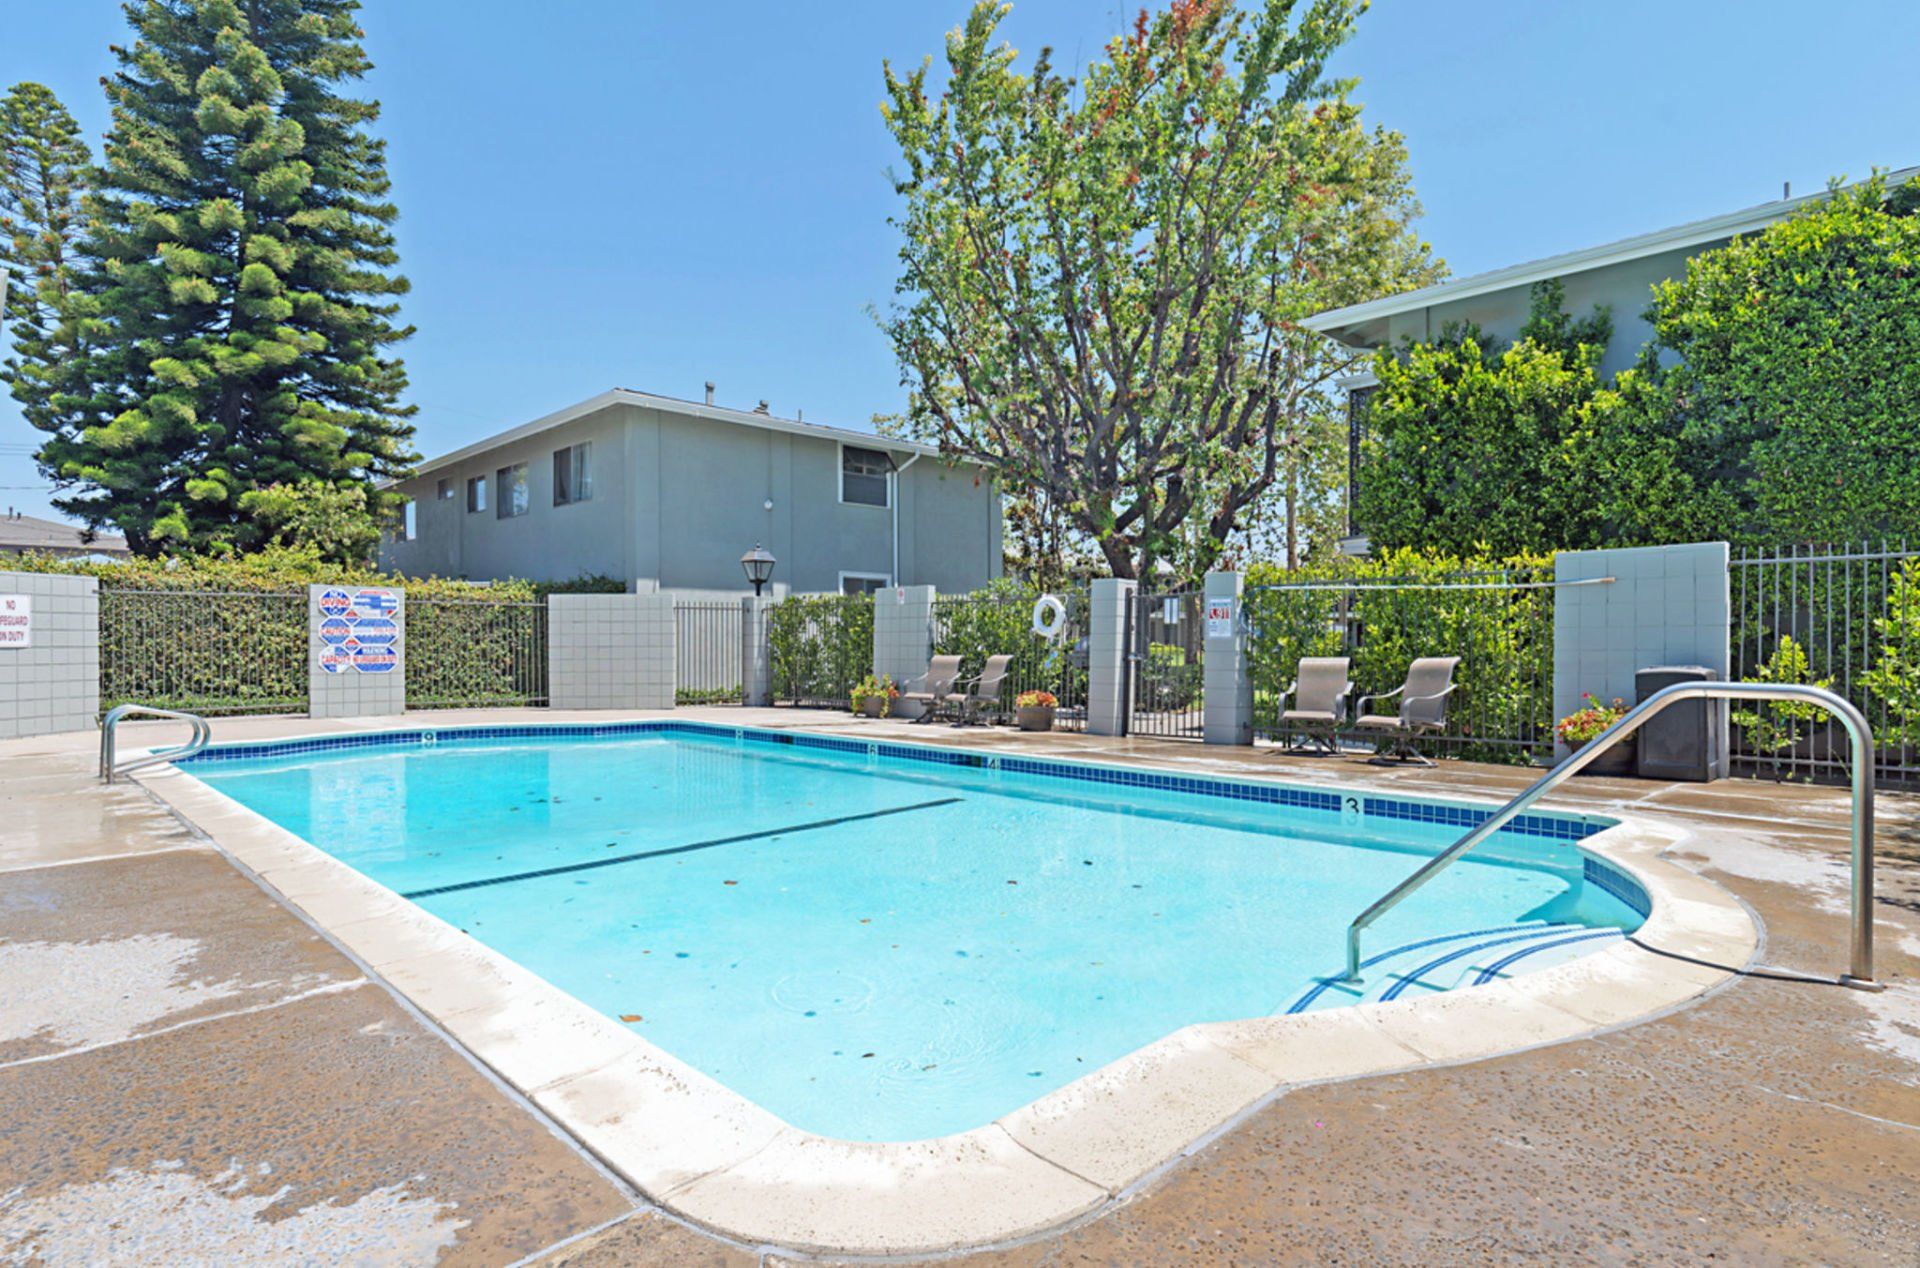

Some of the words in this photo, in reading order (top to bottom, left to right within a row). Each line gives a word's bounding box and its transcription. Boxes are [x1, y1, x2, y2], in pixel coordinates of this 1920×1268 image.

[6, 600, 16, 610] NO
[321, 598, 351, 607] DIVING
[8, 631, 24, 641] DUTY
[320, 627, 351, 636] CAUTION
[1346, 797, 1359, 814] 3
